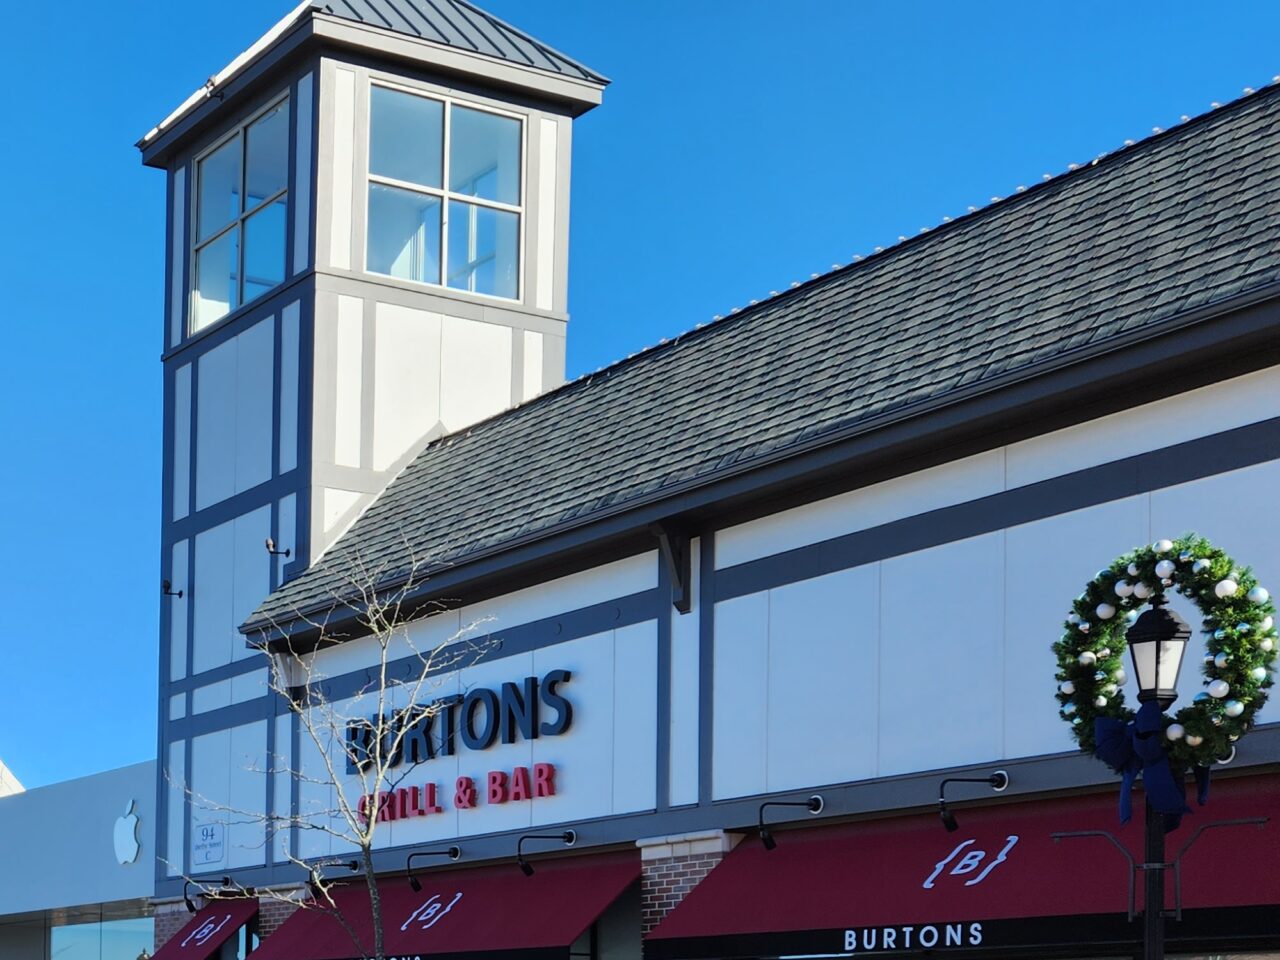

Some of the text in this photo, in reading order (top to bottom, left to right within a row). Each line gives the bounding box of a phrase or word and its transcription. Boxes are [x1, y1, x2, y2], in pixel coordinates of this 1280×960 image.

[346, 669, 572, 775] BURTONS
[357, 762, 555, 825] GRILL & BAR
[202, 827, 215, 841] 94
[844, 922, 983, 951] BURTONS
